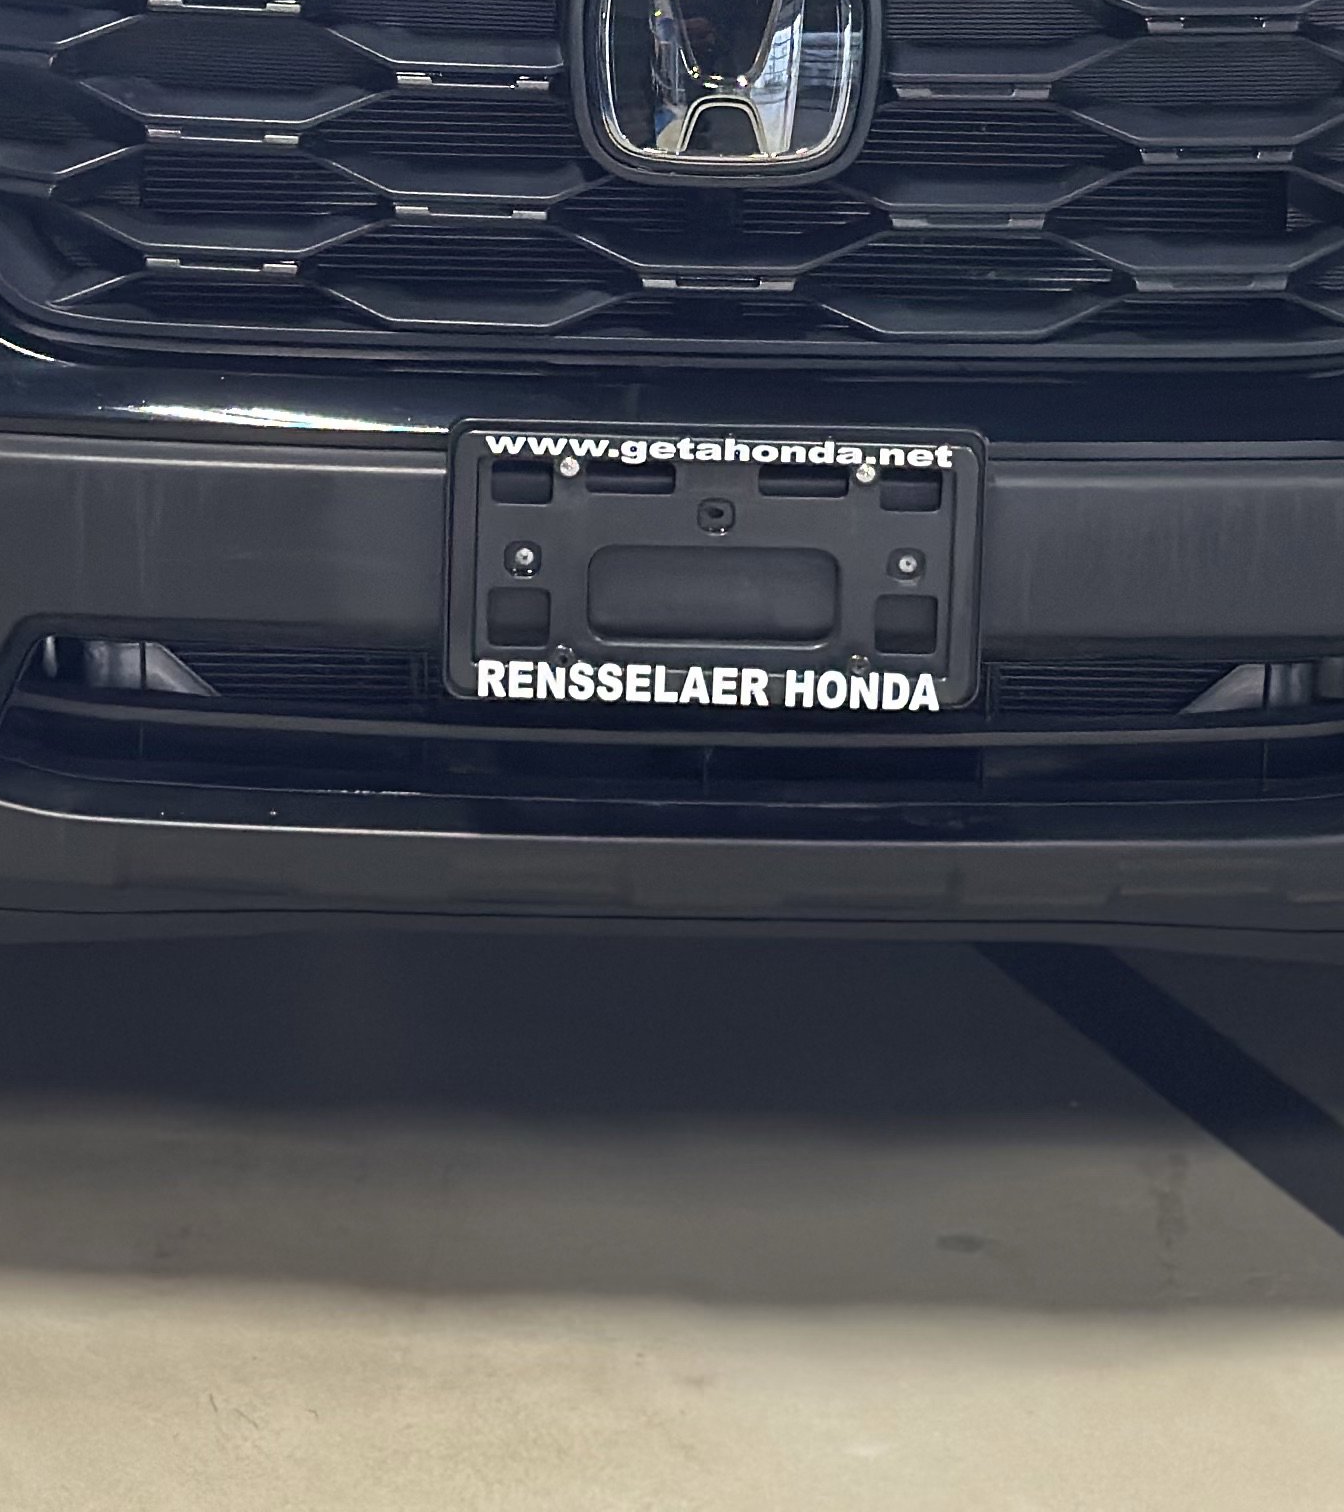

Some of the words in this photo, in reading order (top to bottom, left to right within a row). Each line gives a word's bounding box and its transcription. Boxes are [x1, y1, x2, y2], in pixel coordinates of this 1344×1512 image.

[485, 435, 953, 468] www.getahonda.net
[477, 659, 769, 707] RENSSELAER
[784, 669, 940, 712] HONDA
